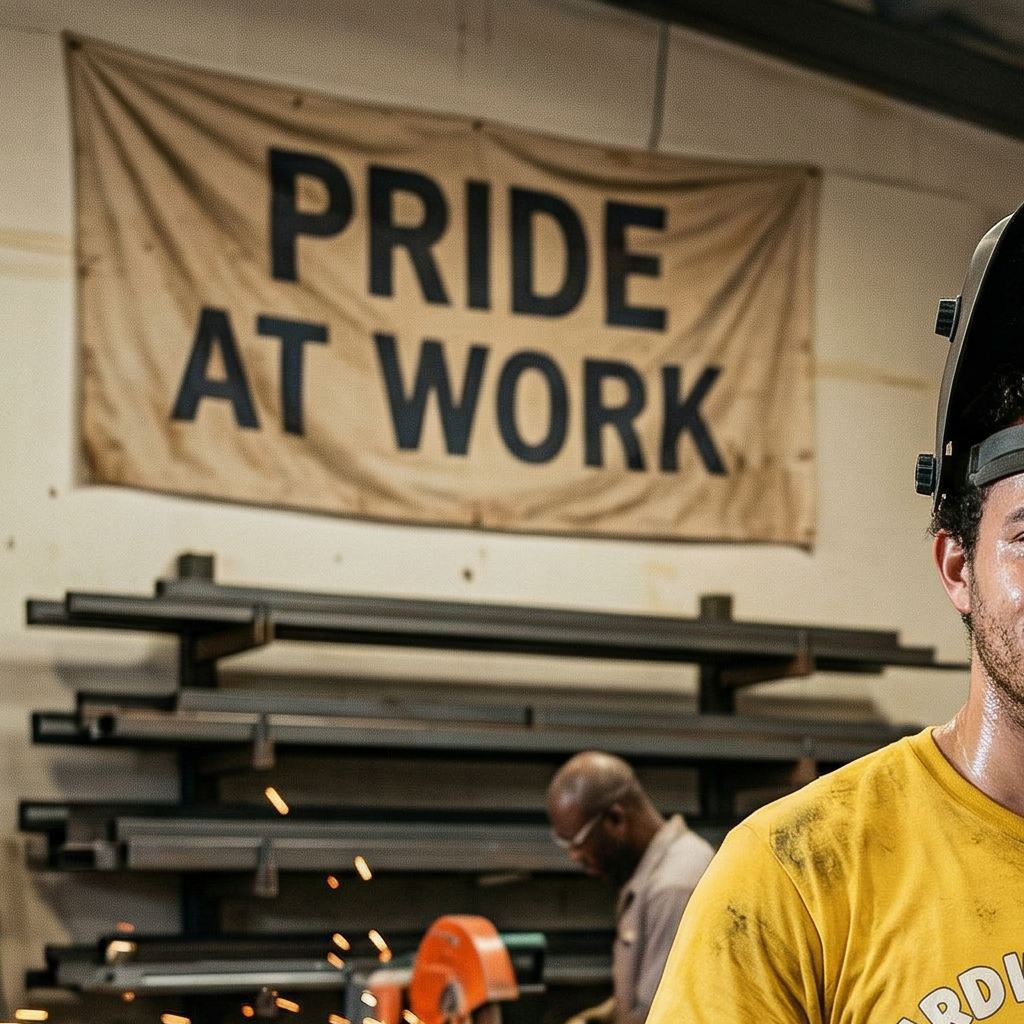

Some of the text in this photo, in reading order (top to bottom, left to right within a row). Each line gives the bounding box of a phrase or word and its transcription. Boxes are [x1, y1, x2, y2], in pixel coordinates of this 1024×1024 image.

[267, 145, 669, 333] PRIDE
[171, 306, 729, 478] AT WORK
